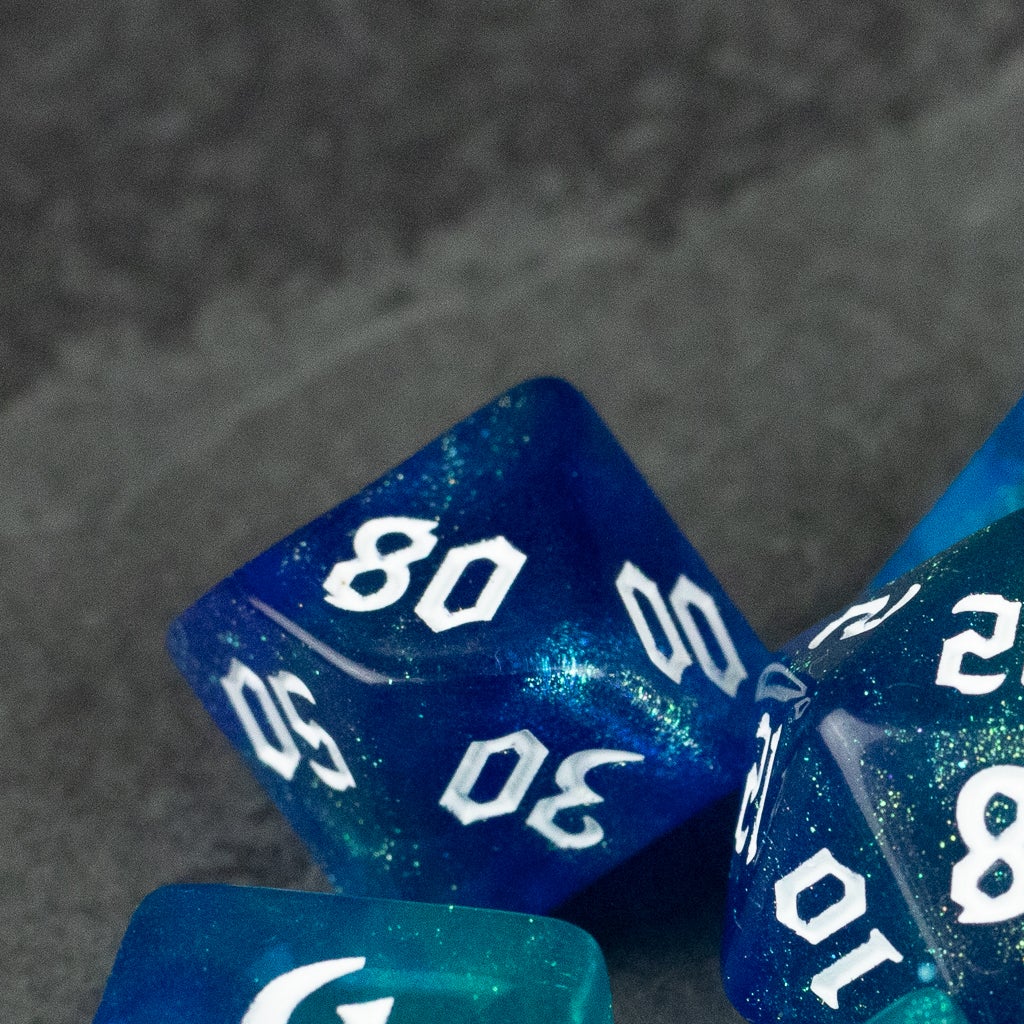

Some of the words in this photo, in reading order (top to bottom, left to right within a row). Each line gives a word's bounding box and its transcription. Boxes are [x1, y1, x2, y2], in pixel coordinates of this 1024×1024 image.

[322, 516, 529, 634] 80
[438, 728, 647, 850] 30
[774, 847, 905, 1011] 10
